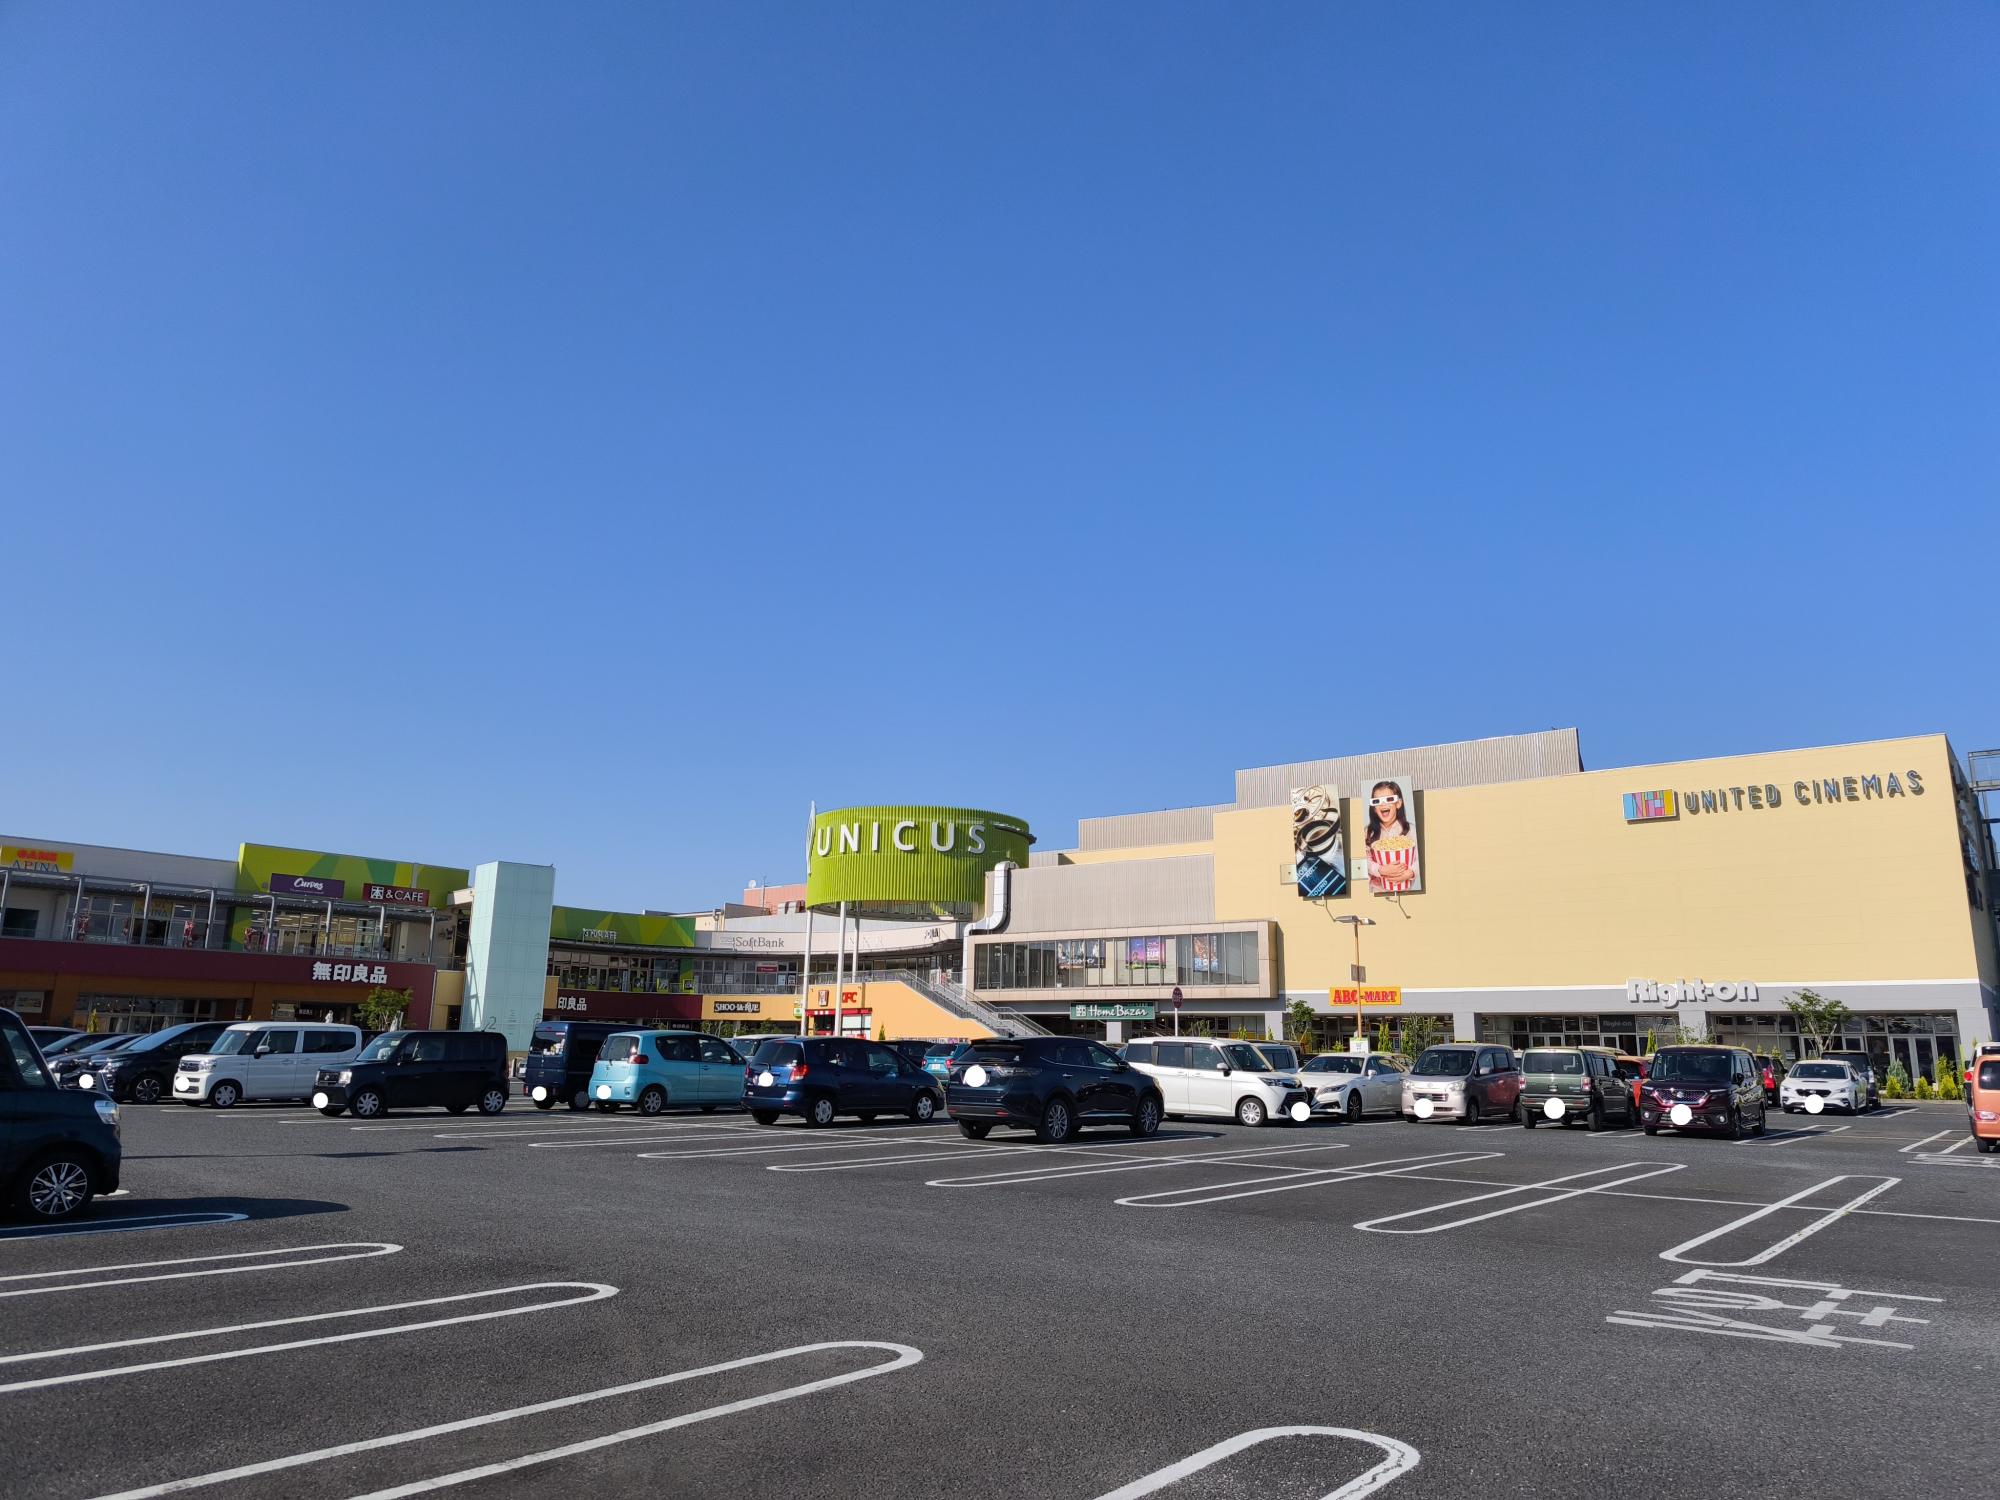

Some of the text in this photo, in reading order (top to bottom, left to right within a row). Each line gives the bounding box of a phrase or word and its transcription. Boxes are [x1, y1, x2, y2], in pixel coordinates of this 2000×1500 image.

[1684, 769, 1922, 813] UNITED CINEMAS
[817, 820, 987, 857] UNICUS
[12, 859, 60, 873] APINA
[293, 877, 324, 891] Curves
[735, 936, 785, 948] SoftBank
[312, 961, 388, 984] 無印良品
[1333, 989, 1398, 1005] ABC-MART
[1627, 976, 1759, 1009] Right-on
